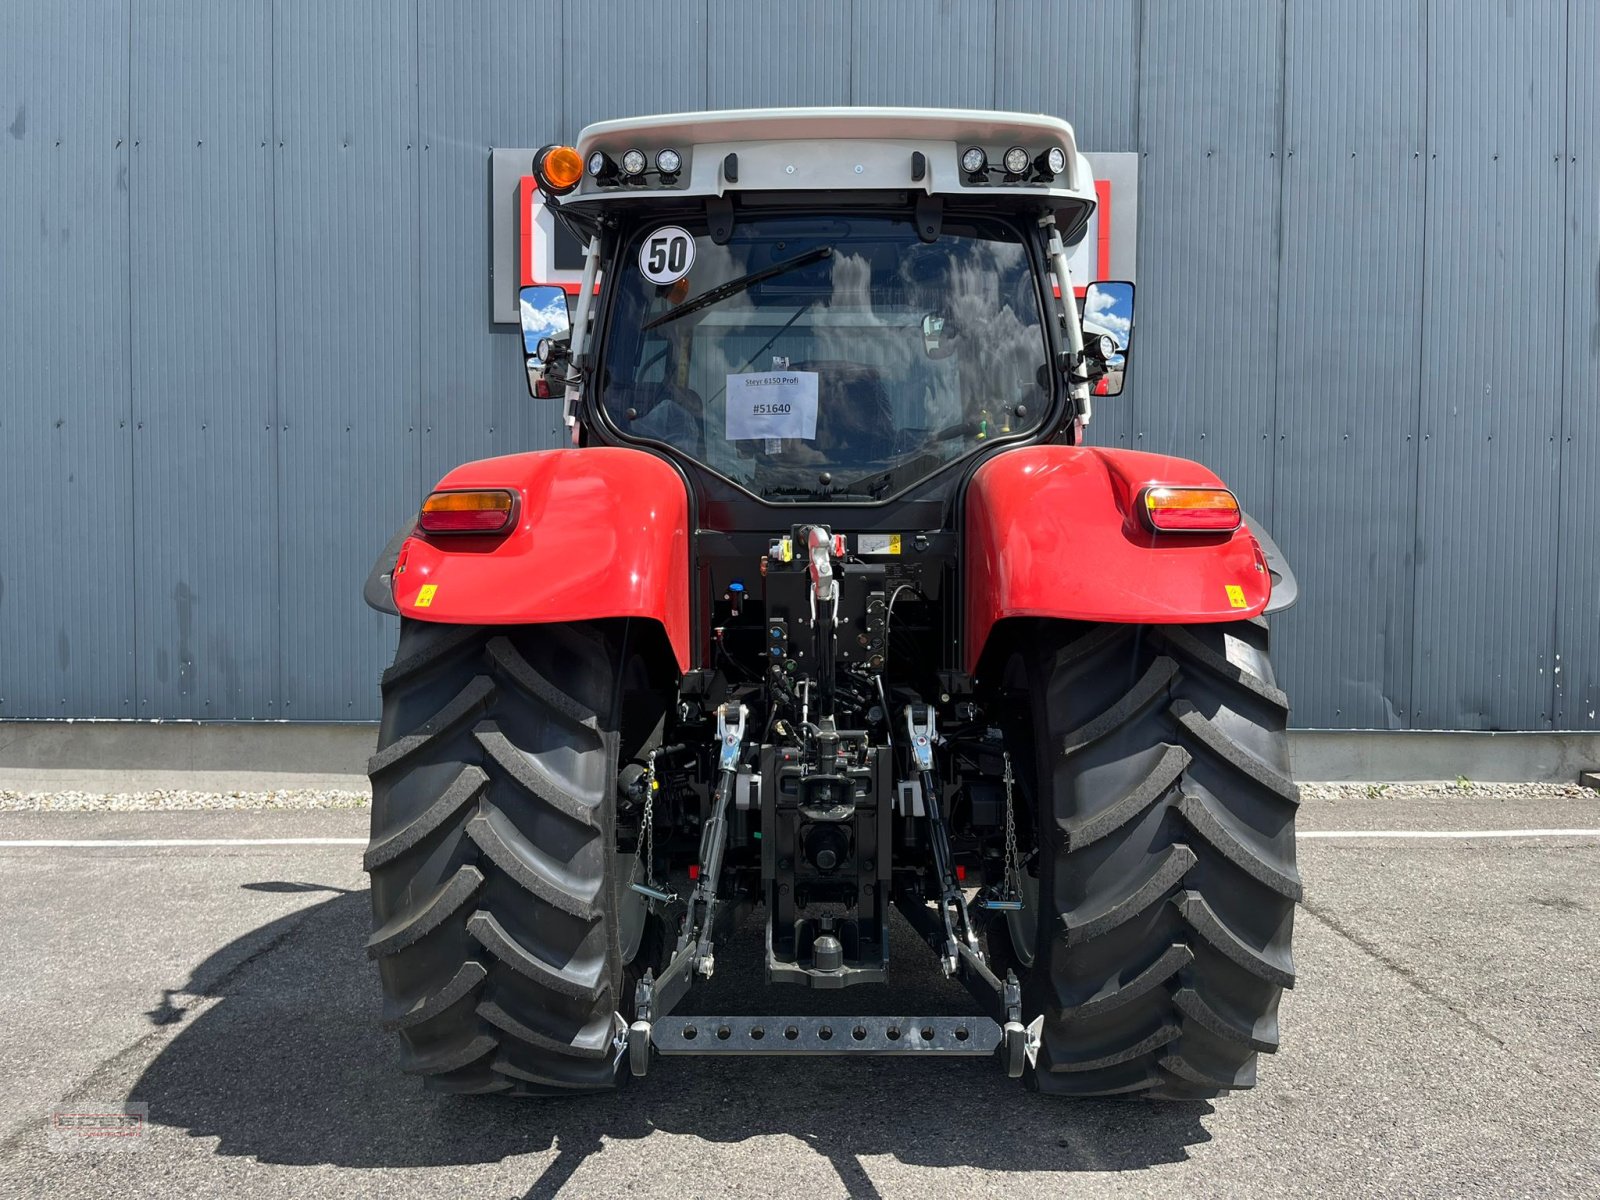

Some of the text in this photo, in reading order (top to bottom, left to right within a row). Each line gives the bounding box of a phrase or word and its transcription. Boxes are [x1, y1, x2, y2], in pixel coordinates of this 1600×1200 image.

[648, 236, 688, 274] 50
[745, 376, 799, 387] Steyr 6150 Profi
[753, 403, 791, 415] #51640
